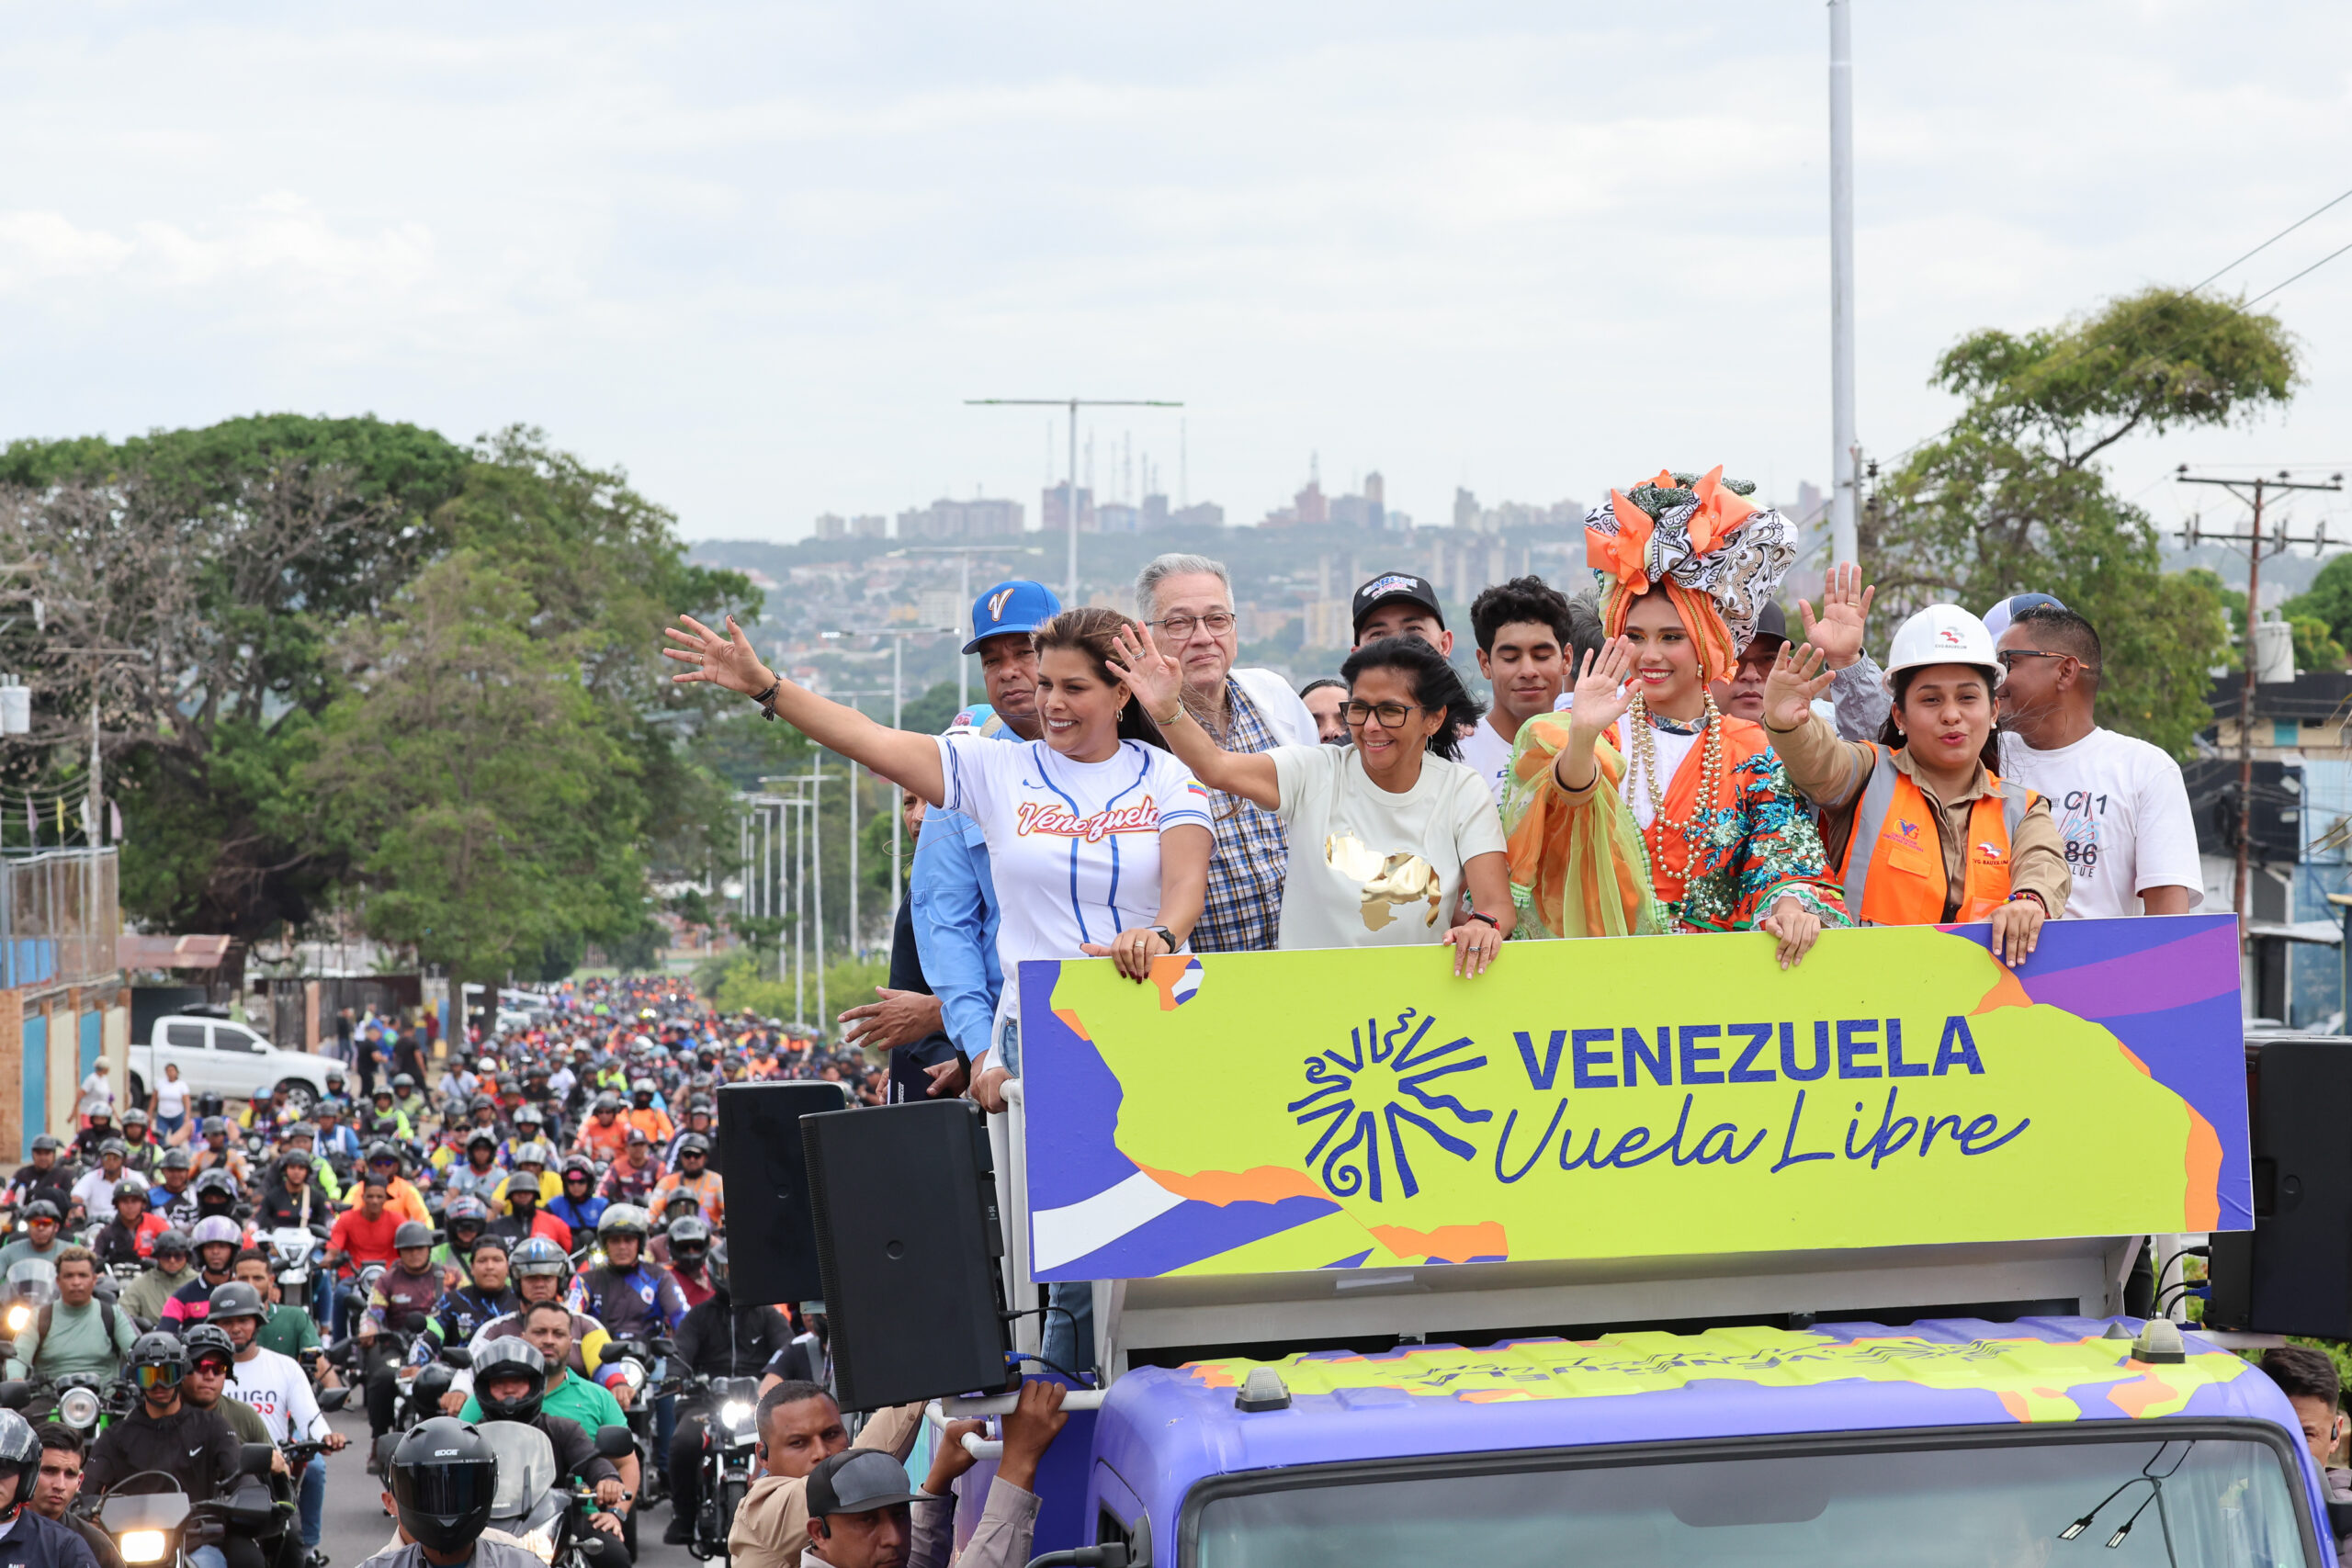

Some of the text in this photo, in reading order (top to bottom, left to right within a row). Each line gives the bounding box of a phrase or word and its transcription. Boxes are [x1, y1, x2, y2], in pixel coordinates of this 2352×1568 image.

[988, 588, 1014, 621] V
[2065, 818, 2101, 843] 25
[2064, 840, 2098, 865] 86
[2071, 866, 2096, 878] LUE
[1513, 1016, 1985, 1090] VENEZUELA
[1495, 1085, 2031, 1184] Vuela Libre
[434, 1449, 459, 1457] EDGE
